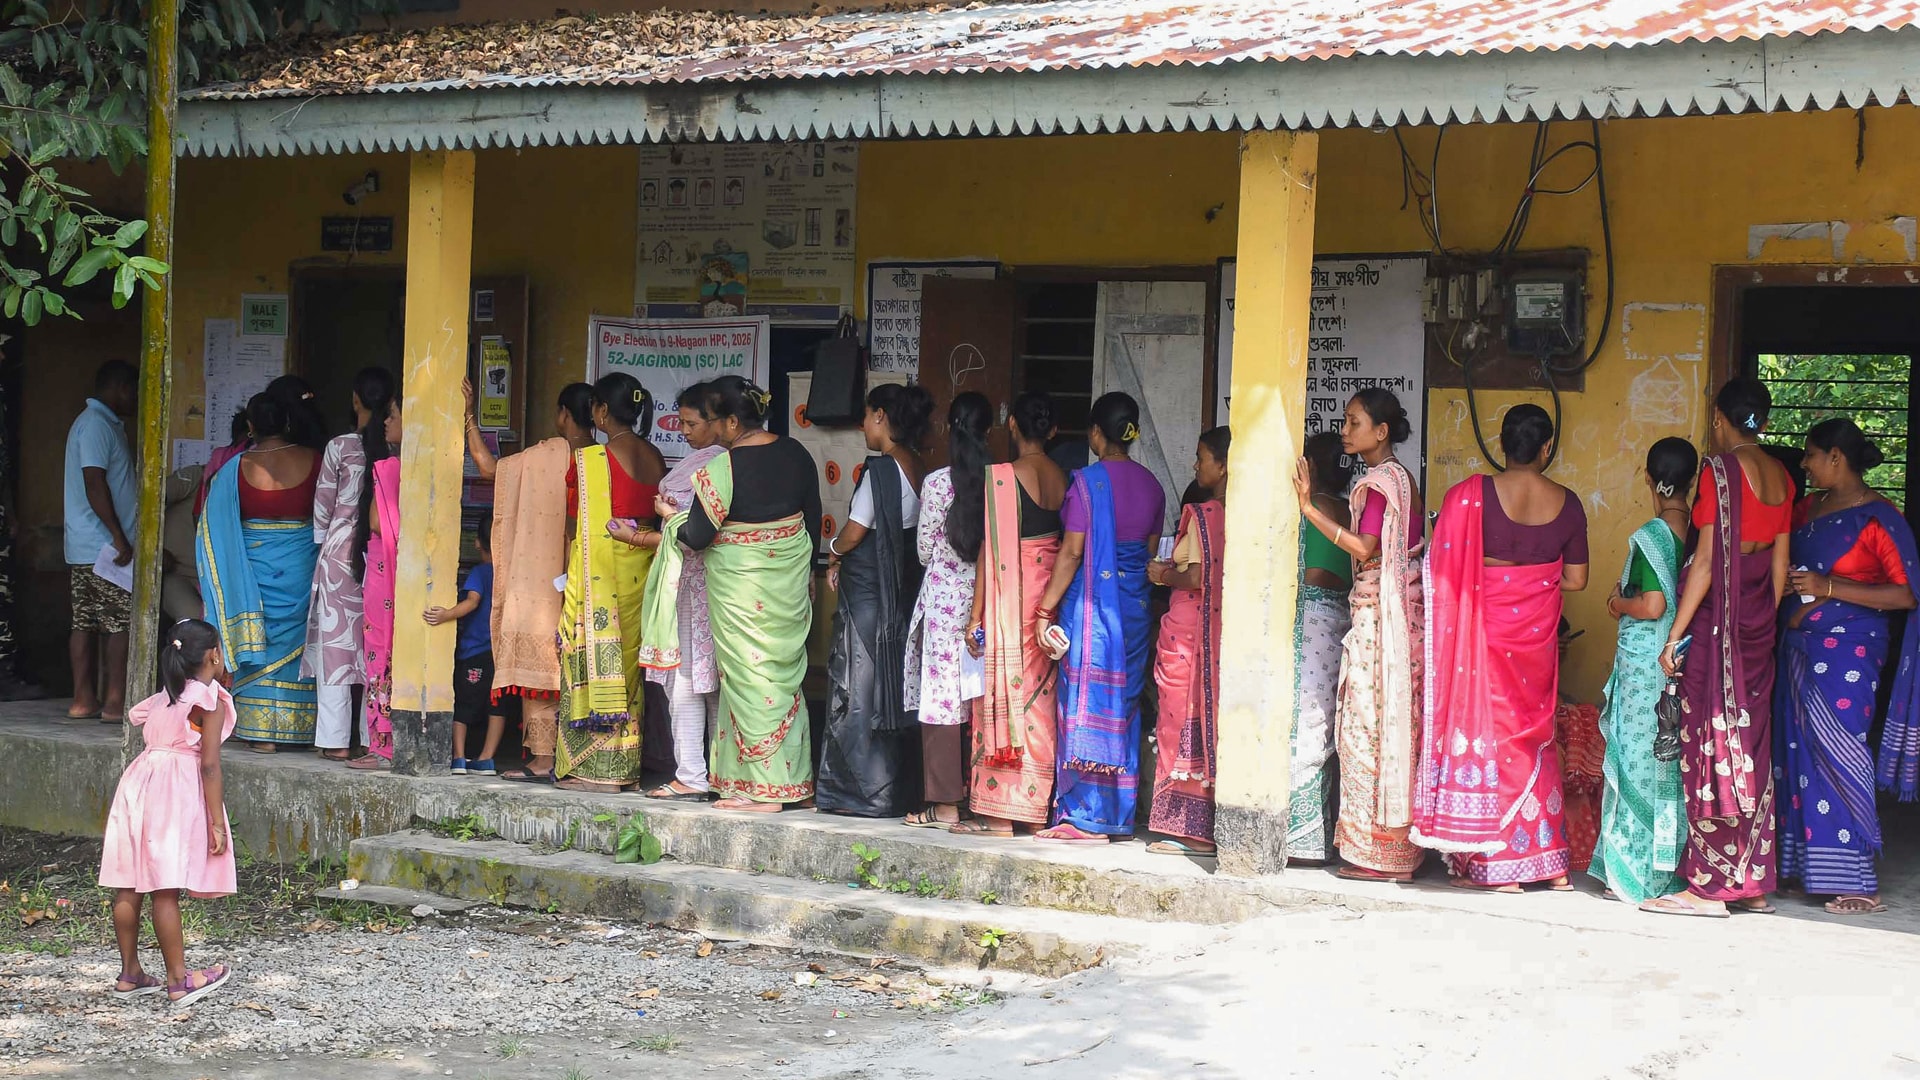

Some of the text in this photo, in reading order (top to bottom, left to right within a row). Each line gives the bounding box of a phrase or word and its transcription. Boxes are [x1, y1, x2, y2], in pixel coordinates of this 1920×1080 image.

[251, 304, 278, 316] MALE
[603, 331, 751, 350] Bye Election to 9-Nagaon HPC, 2026
[607, 350, 744, 371] 52-JAGIROAD (SC) LAC
[489, 403, 502, 411] CCTV
[655, 432, 674, 443] H.S.
[828, 465, 835, 481] 6
[824, 518, 831, 534] 9
